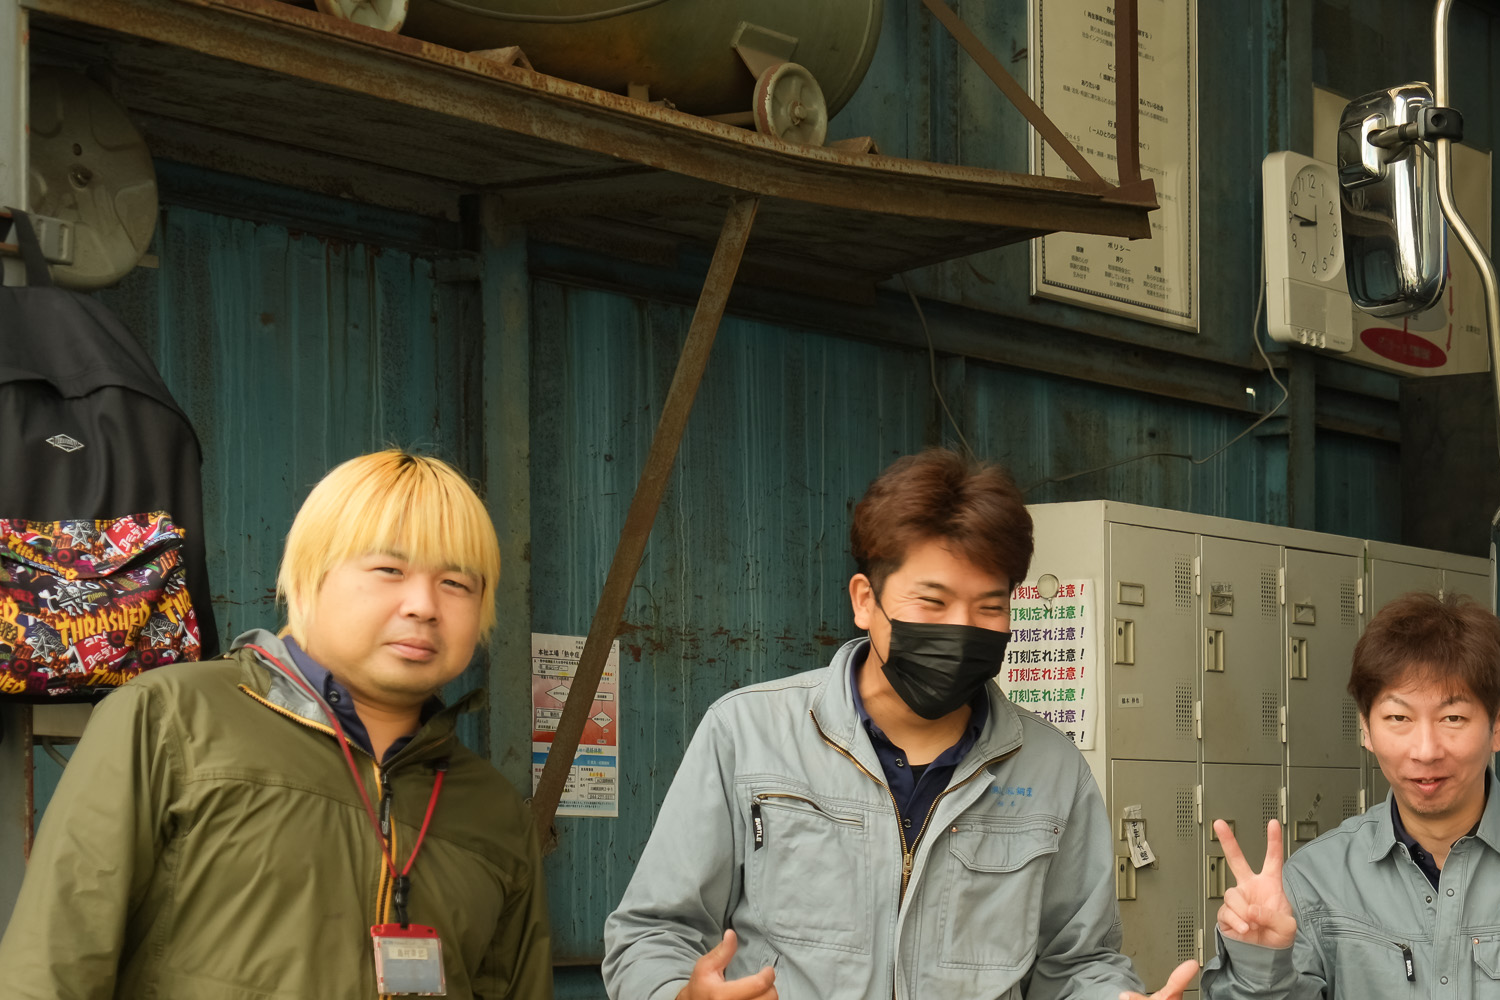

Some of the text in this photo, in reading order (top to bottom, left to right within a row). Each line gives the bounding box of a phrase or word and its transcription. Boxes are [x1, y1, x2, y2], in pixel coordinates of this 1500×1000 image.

[1297, 176, 1305, 192] 11
[1307, 174, 1316, 189] 12
[1290, 190, 1299, 207] 10
[1329, 200, 1335, 215] 2
[1332, 223, 1339, 237] 3
[1107, 242, 1131, 252] ポリシー
[1291, 233, 1298, 248] 8
[1301, 251, 1307, 264] 7
[1321, 257, 1328, 271] 5
[1311, 260, 1317, 274] 6
[1007, 648, 1084, 664] 打刻忘れ注意！
[1008, 667, 1084, 683] 打刻忘れ注意！
[1008, 688, 1085, 703] 打刻忘れ注意！
